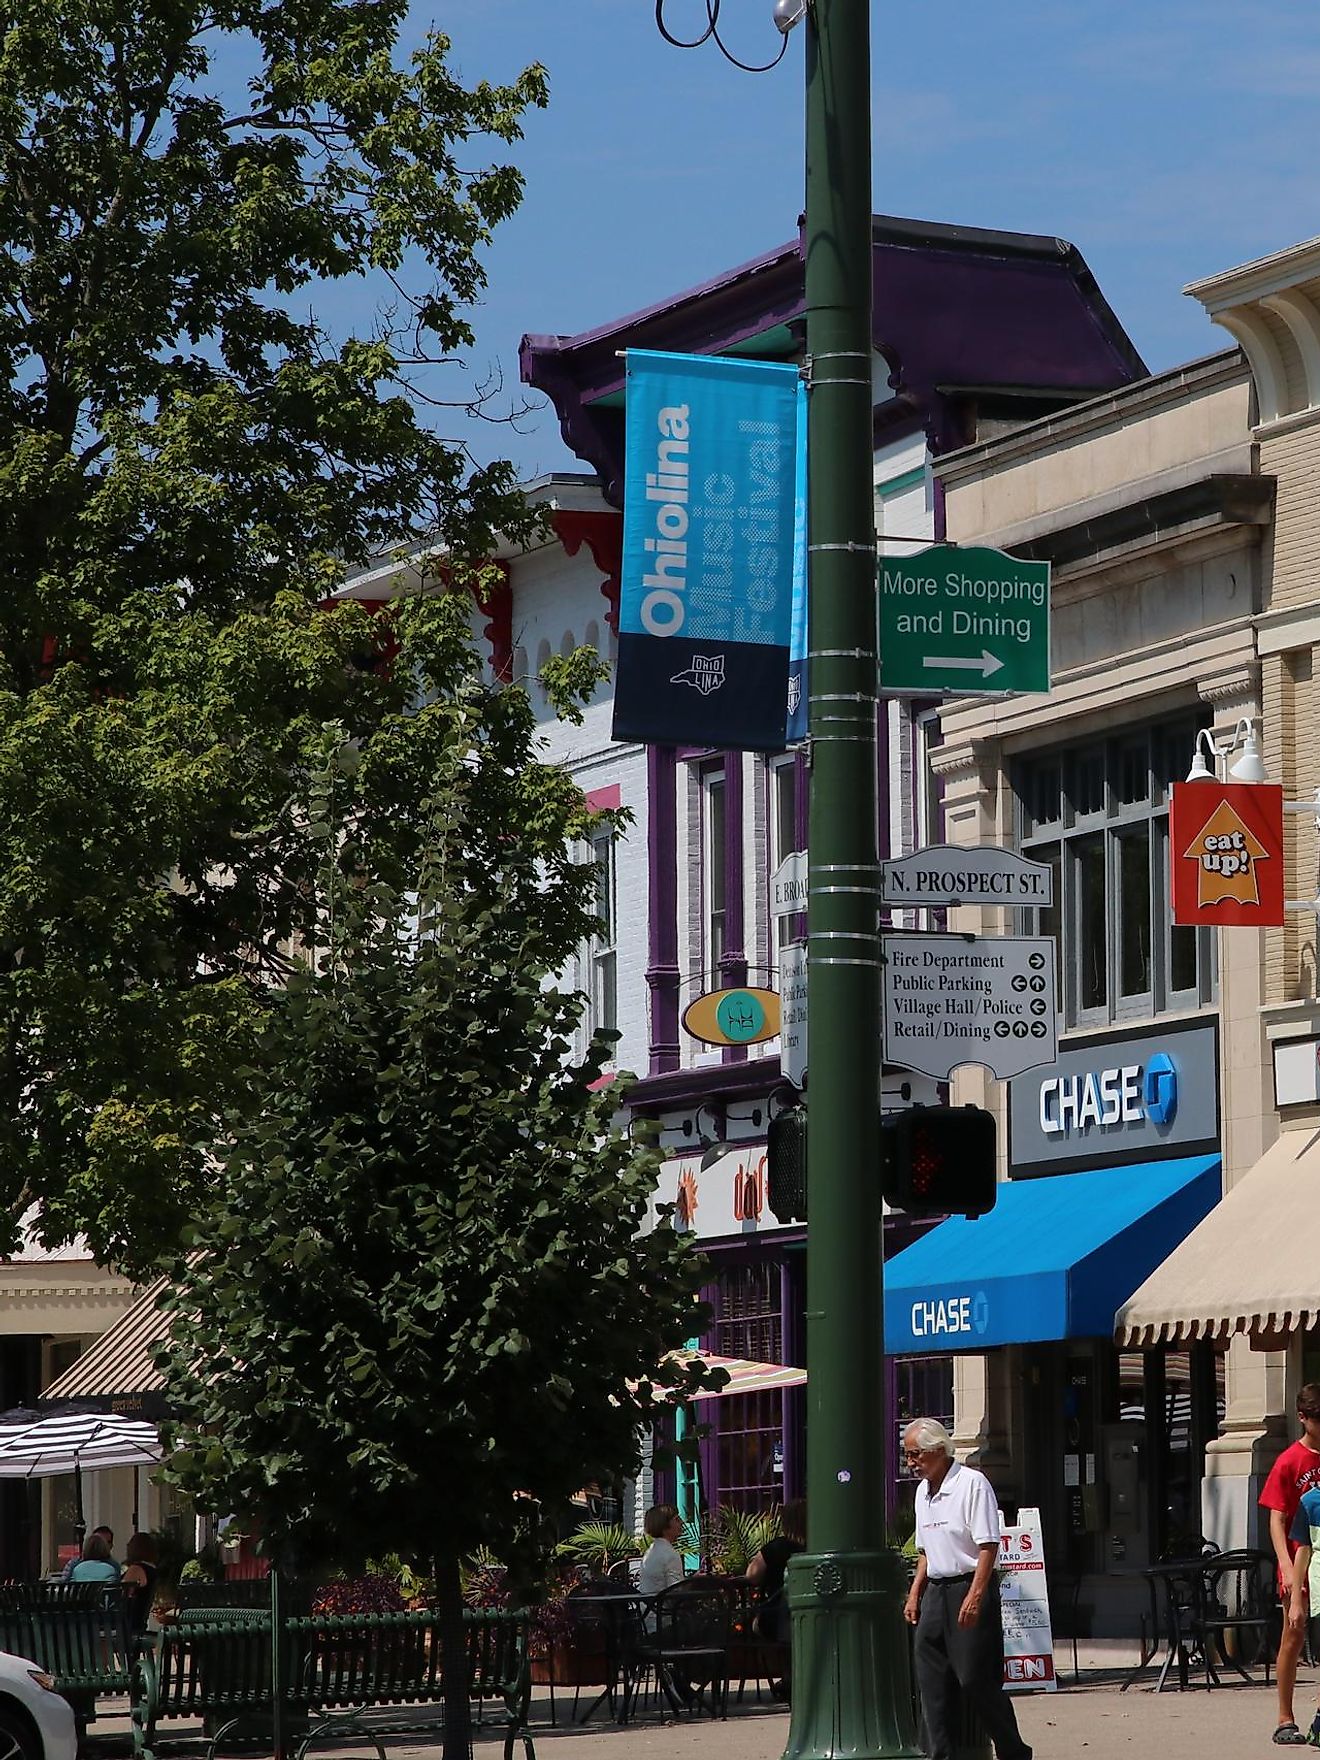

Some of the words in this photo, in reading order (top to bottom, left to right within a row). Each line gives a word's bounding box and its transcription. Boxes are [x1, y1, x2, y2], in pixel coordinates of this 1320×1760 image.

[640, 403, 690, 638] Ohiolina
[733, 420, 782, 646] Festival
[688, 471, 735, 641] Music
[883, 571, 938, 596] More
[945, 573, 1045, 606] Shopping
[896, 610, 943, 635] and
[952, 610, 1031, 643] Dining
[694, 658, 721, 671] OHIO
[694, 672, 721, 686] LINA
[1203, 830, 1244, 851] eat
[1201, 849, 1249, 877] up!
[891, 871, 910, 893] N.
[916, 871, 1015, 894] PROSPECT
[1019, 873, 1045, 895] ST.
[892, 951, 919, 968] Fire
[923, 951, 1005, 972] Department
[892, 974, 935, 991] Public
[938, 974, 993, 995] Parking
[893, 997, 942, 1018] Village
[945, 997, 1023, 1017] Hall/Police
[894, 1020, 991, 1042] Retail/Dining
[1040, 1064, 1144, 1133] CHASE
[911, 1297, 971, 1336] CHASE
[1296, 1469, 1316, 1488] SAINT
[1000, 1534, 1033, 1553] T'S
[1007, 1658, 1046, 1680] EN
